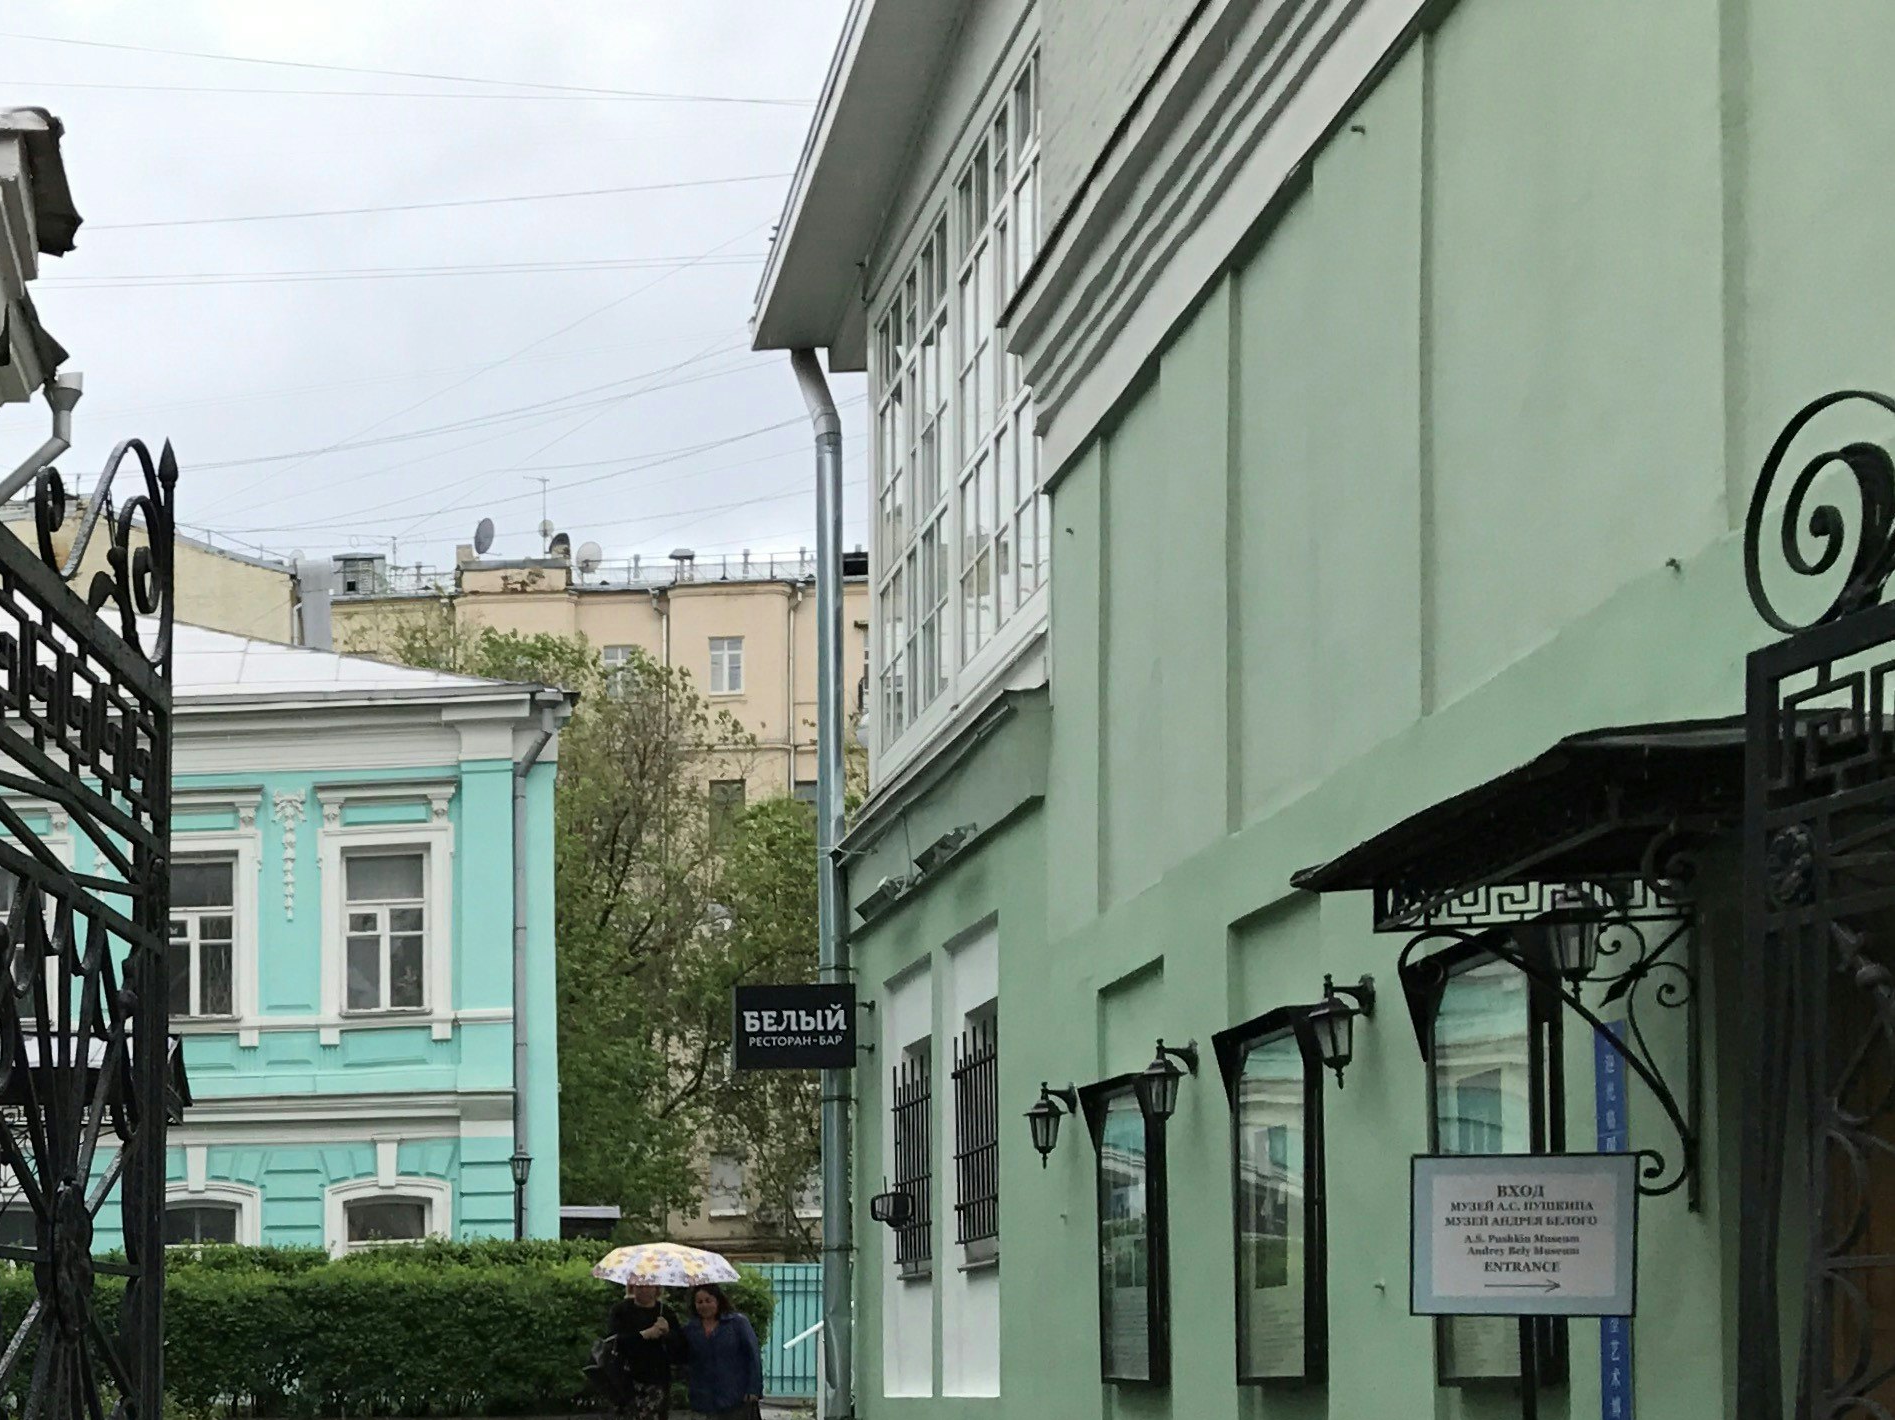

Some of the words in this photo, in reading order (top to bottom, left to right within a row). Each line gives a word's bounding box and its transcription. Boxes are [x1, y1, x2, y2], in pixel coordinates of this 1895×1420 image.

[742, 1003, 847, 1033] БЕЛЫЙ
[1496, 1184, 1545, 1198] ВХОД
[1484, 1261, 1562, 1274] ENTRANCE
